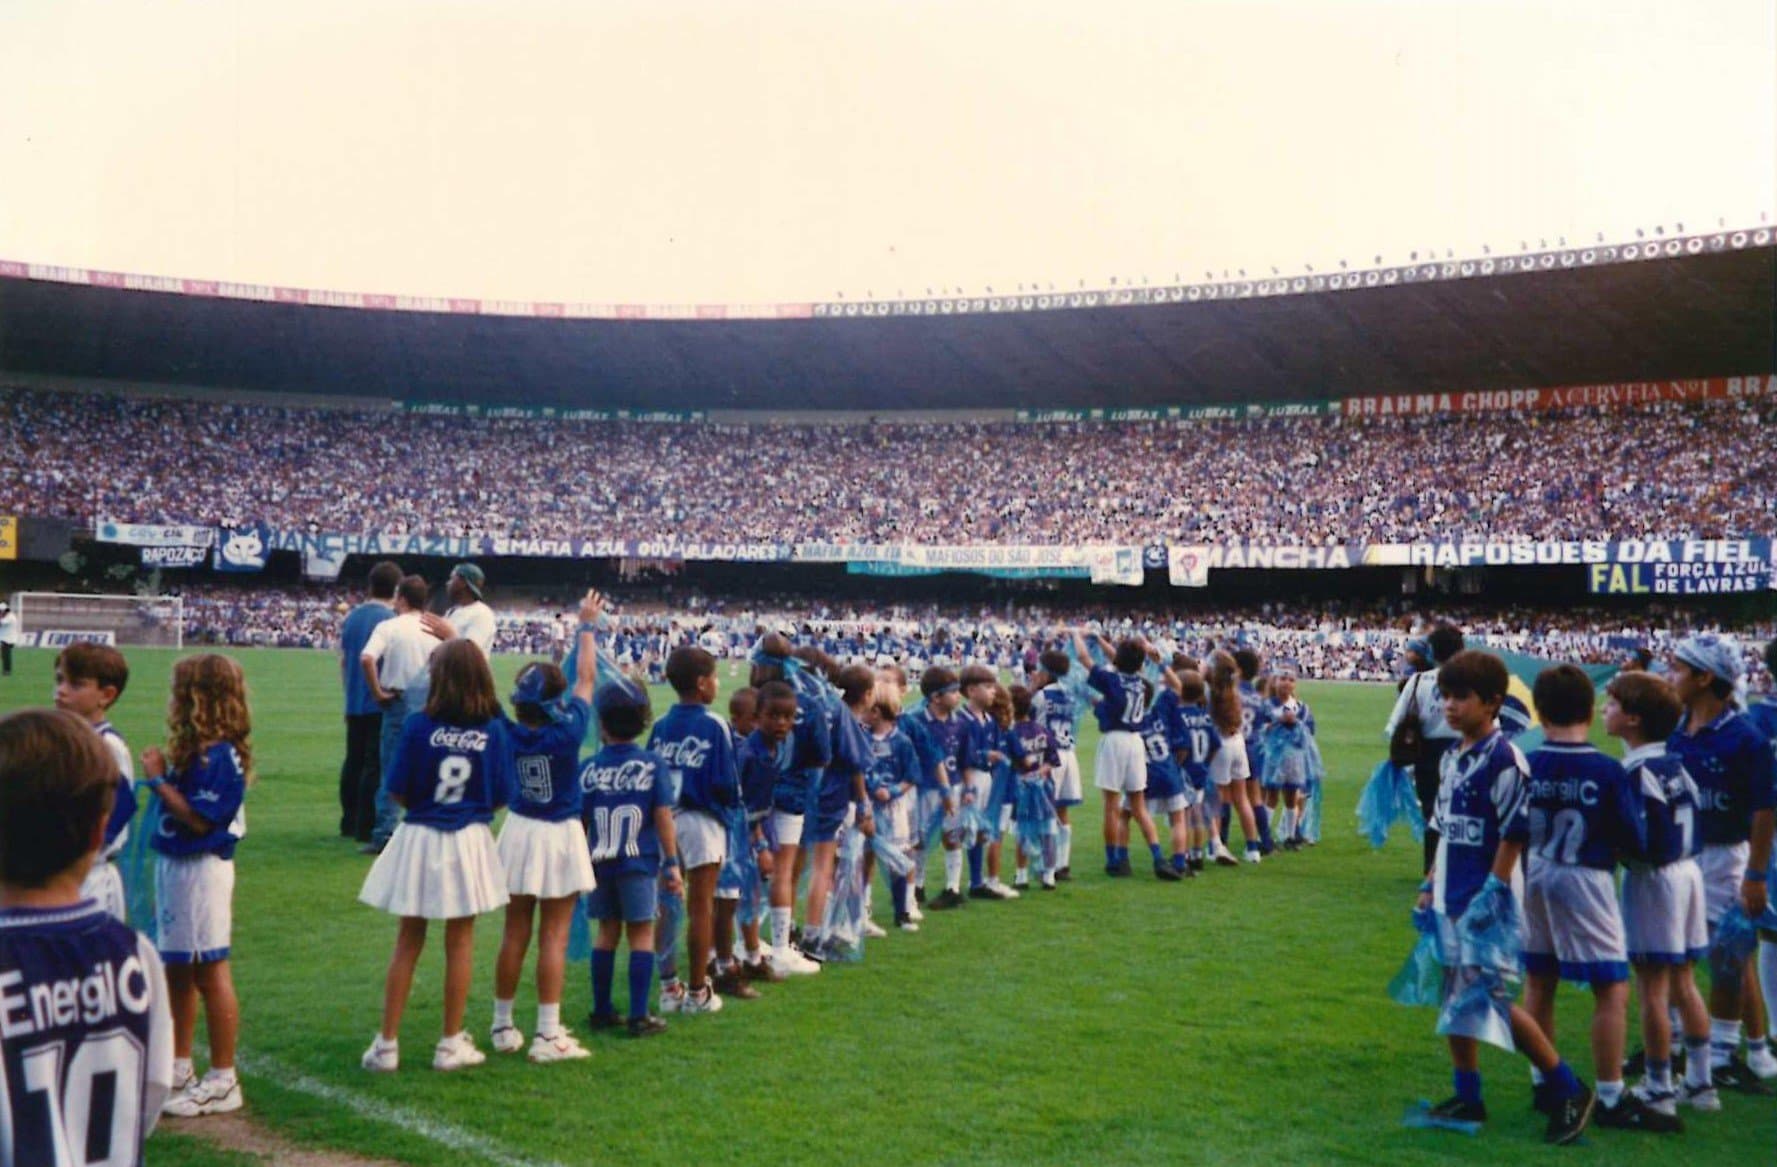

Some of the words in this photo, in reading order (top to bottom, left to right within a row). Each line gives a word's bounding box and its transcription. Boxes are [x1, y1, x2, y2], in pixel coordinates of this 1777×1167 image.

[1348, 393, 1451, 416] BRAHMA
[1463, 389, 1540, 411] CHOPP
[580, 539, 629, 557] AZUL
[1617, 540, 1672, 563] DA
[1681, 539, 1761, 563] FIEL
[1591, 563, 1650, 593] FAL
[1654, 562, 1717, 579] FORÇA
[1722, 560, 1772, 576] AZUL
[1654, 579, 1680, 593] DE
[1684, 576, 1757, 593] LAVRAS
[433, 755, 473, 805] 8
[516, 755, 553, 804] 9
[21, 1026, 146, 1167] 10
